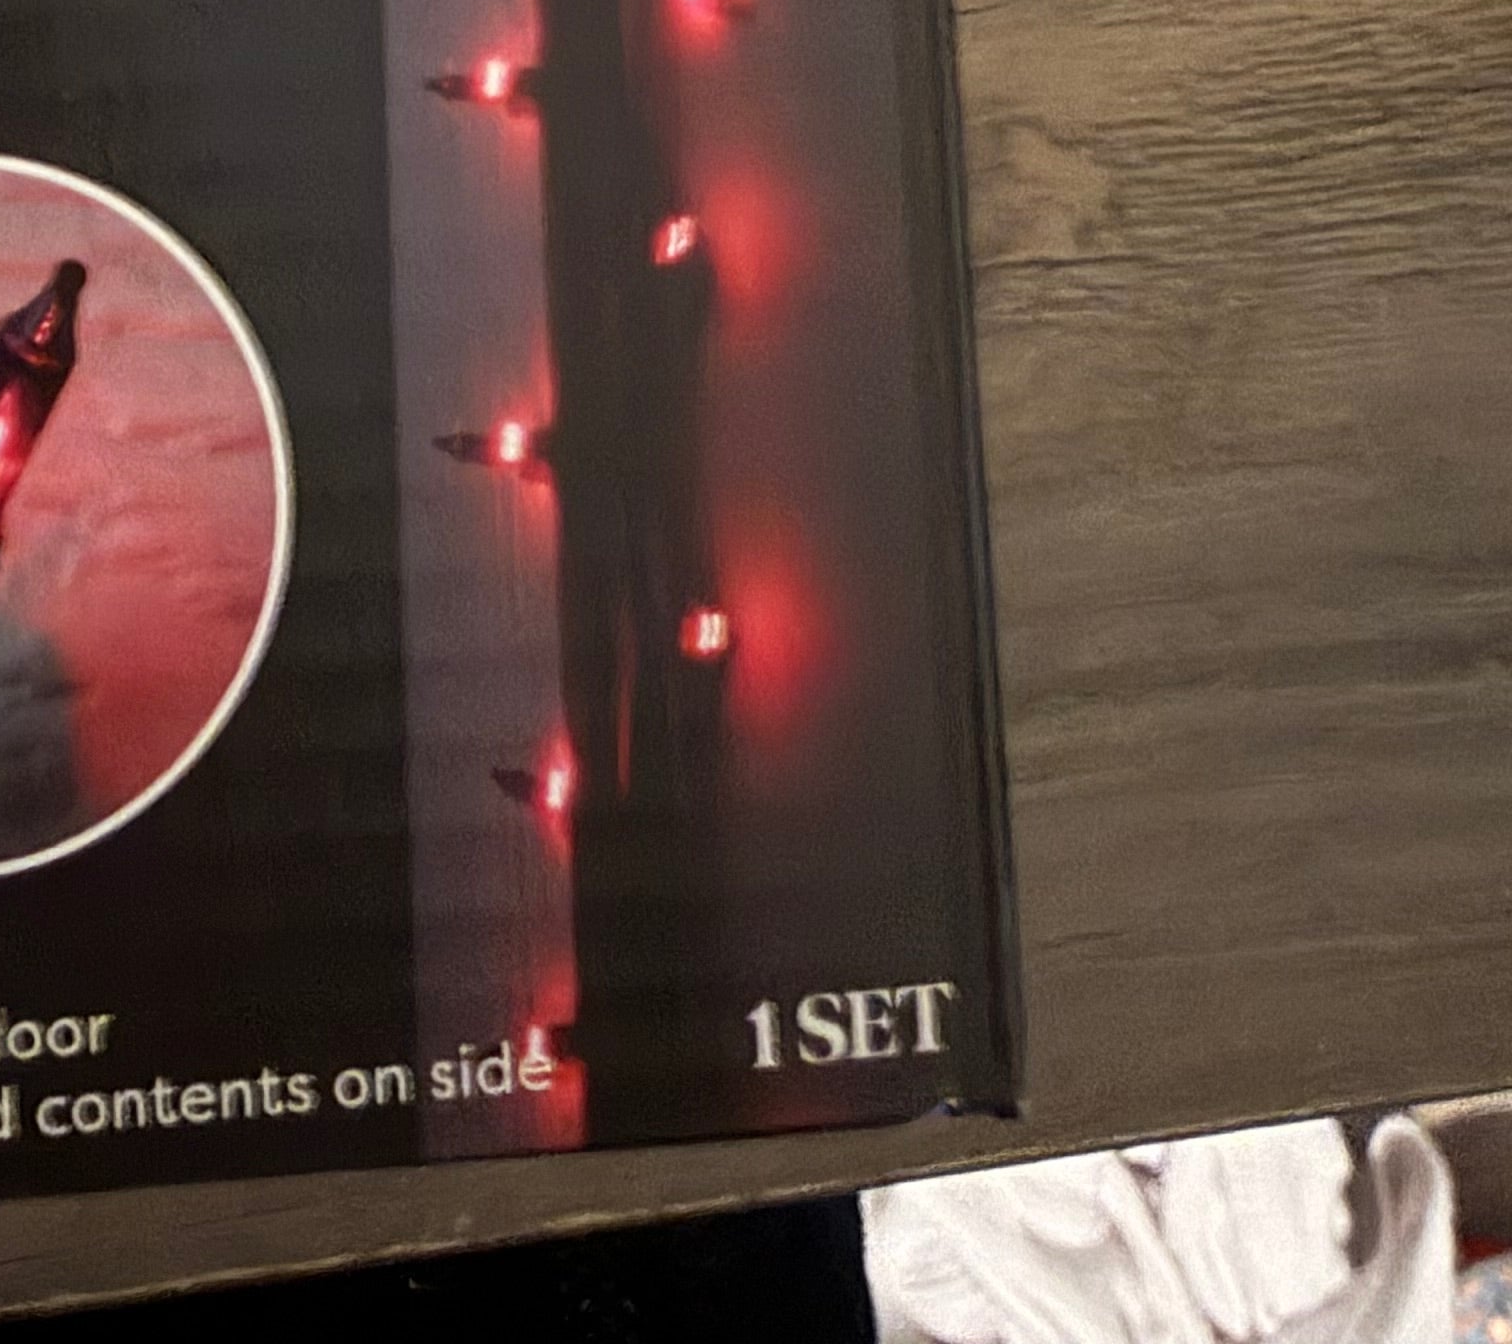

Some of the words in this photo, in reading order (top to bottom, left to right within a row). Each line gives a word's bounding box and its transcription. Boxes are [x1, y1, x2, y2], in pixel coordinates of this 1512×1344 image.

[748, 1002, 782, 1070] 1
[798, 982, 958, 1063] SET
[35, 1064, 319, 1138] contents
[333, 1056, 415, 1110] on
[429, 1037, 554, 1100] side
